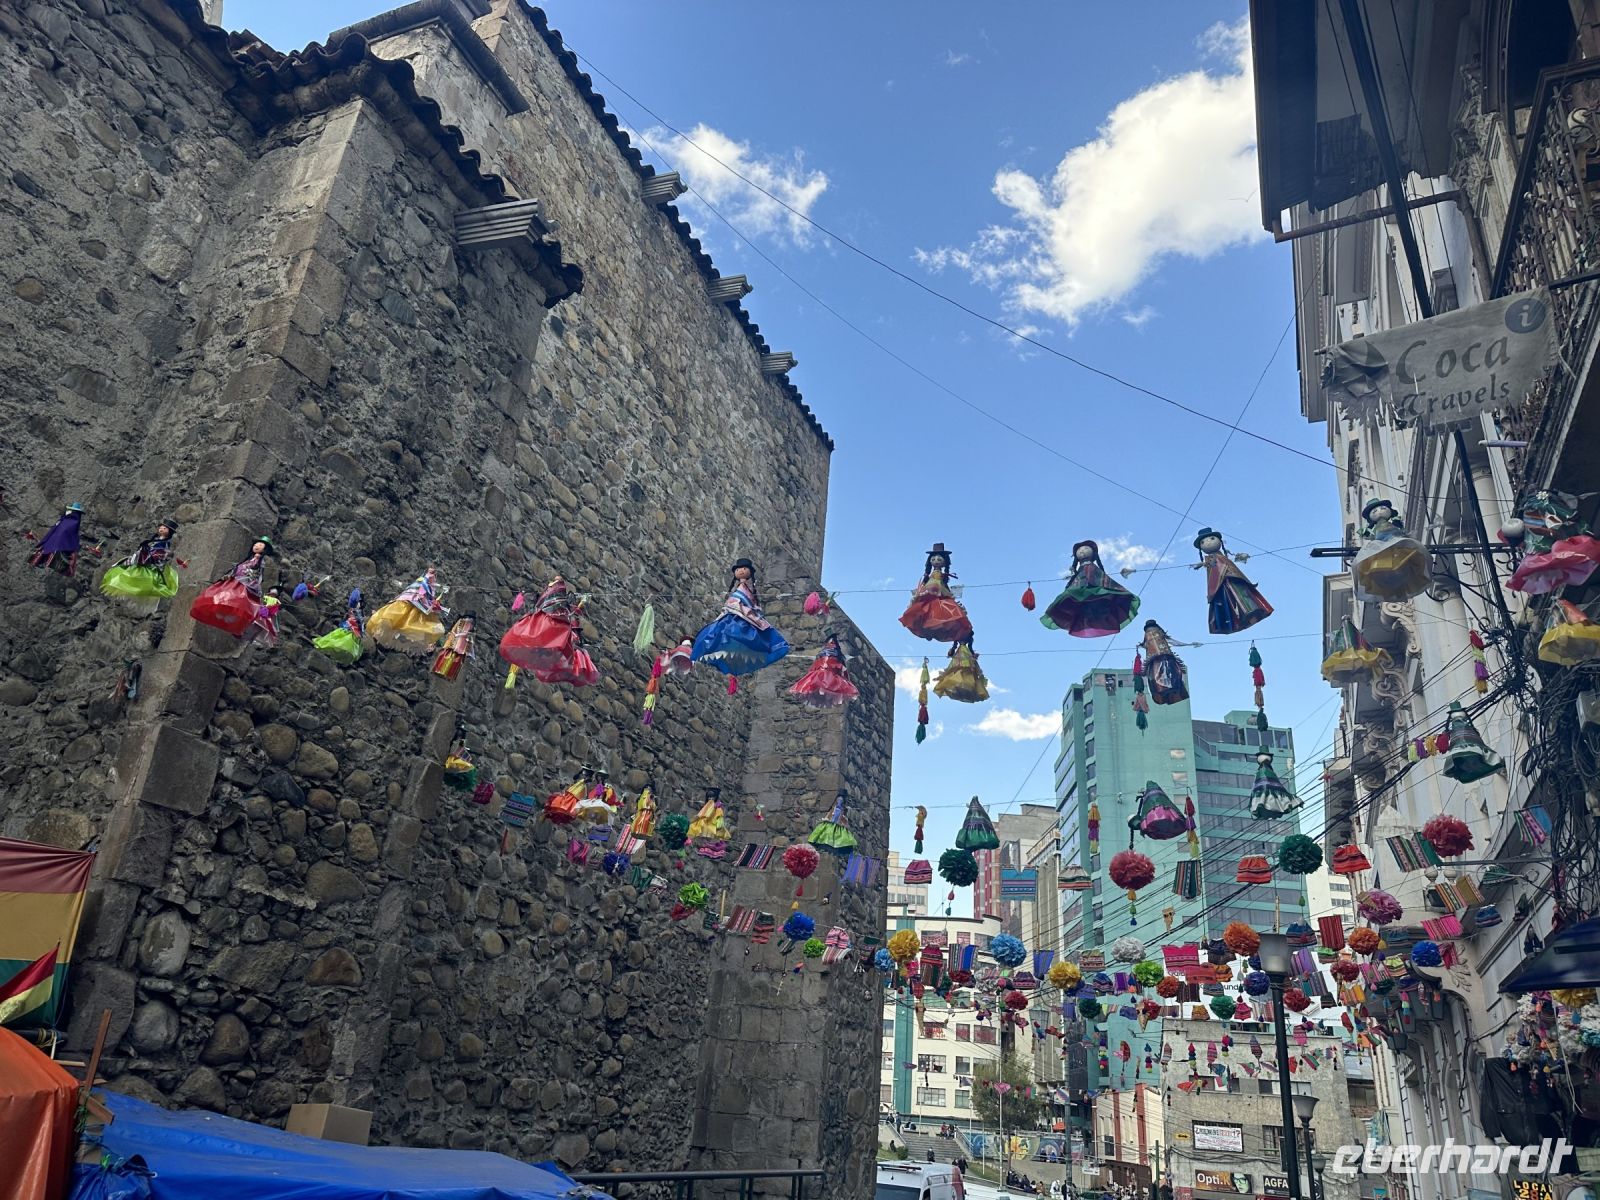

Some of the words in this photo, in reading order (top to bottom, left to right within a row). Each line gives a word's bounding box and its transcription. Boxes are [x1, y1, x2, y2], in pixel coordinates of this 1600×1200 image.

[1396, 336, 1511, 385] Coca
[1402, 374, 1510, 416] Travels
[1264, 1177, 1289, 1189] AGFA
[1513, 1180, 1554, 1193] LOCAL
